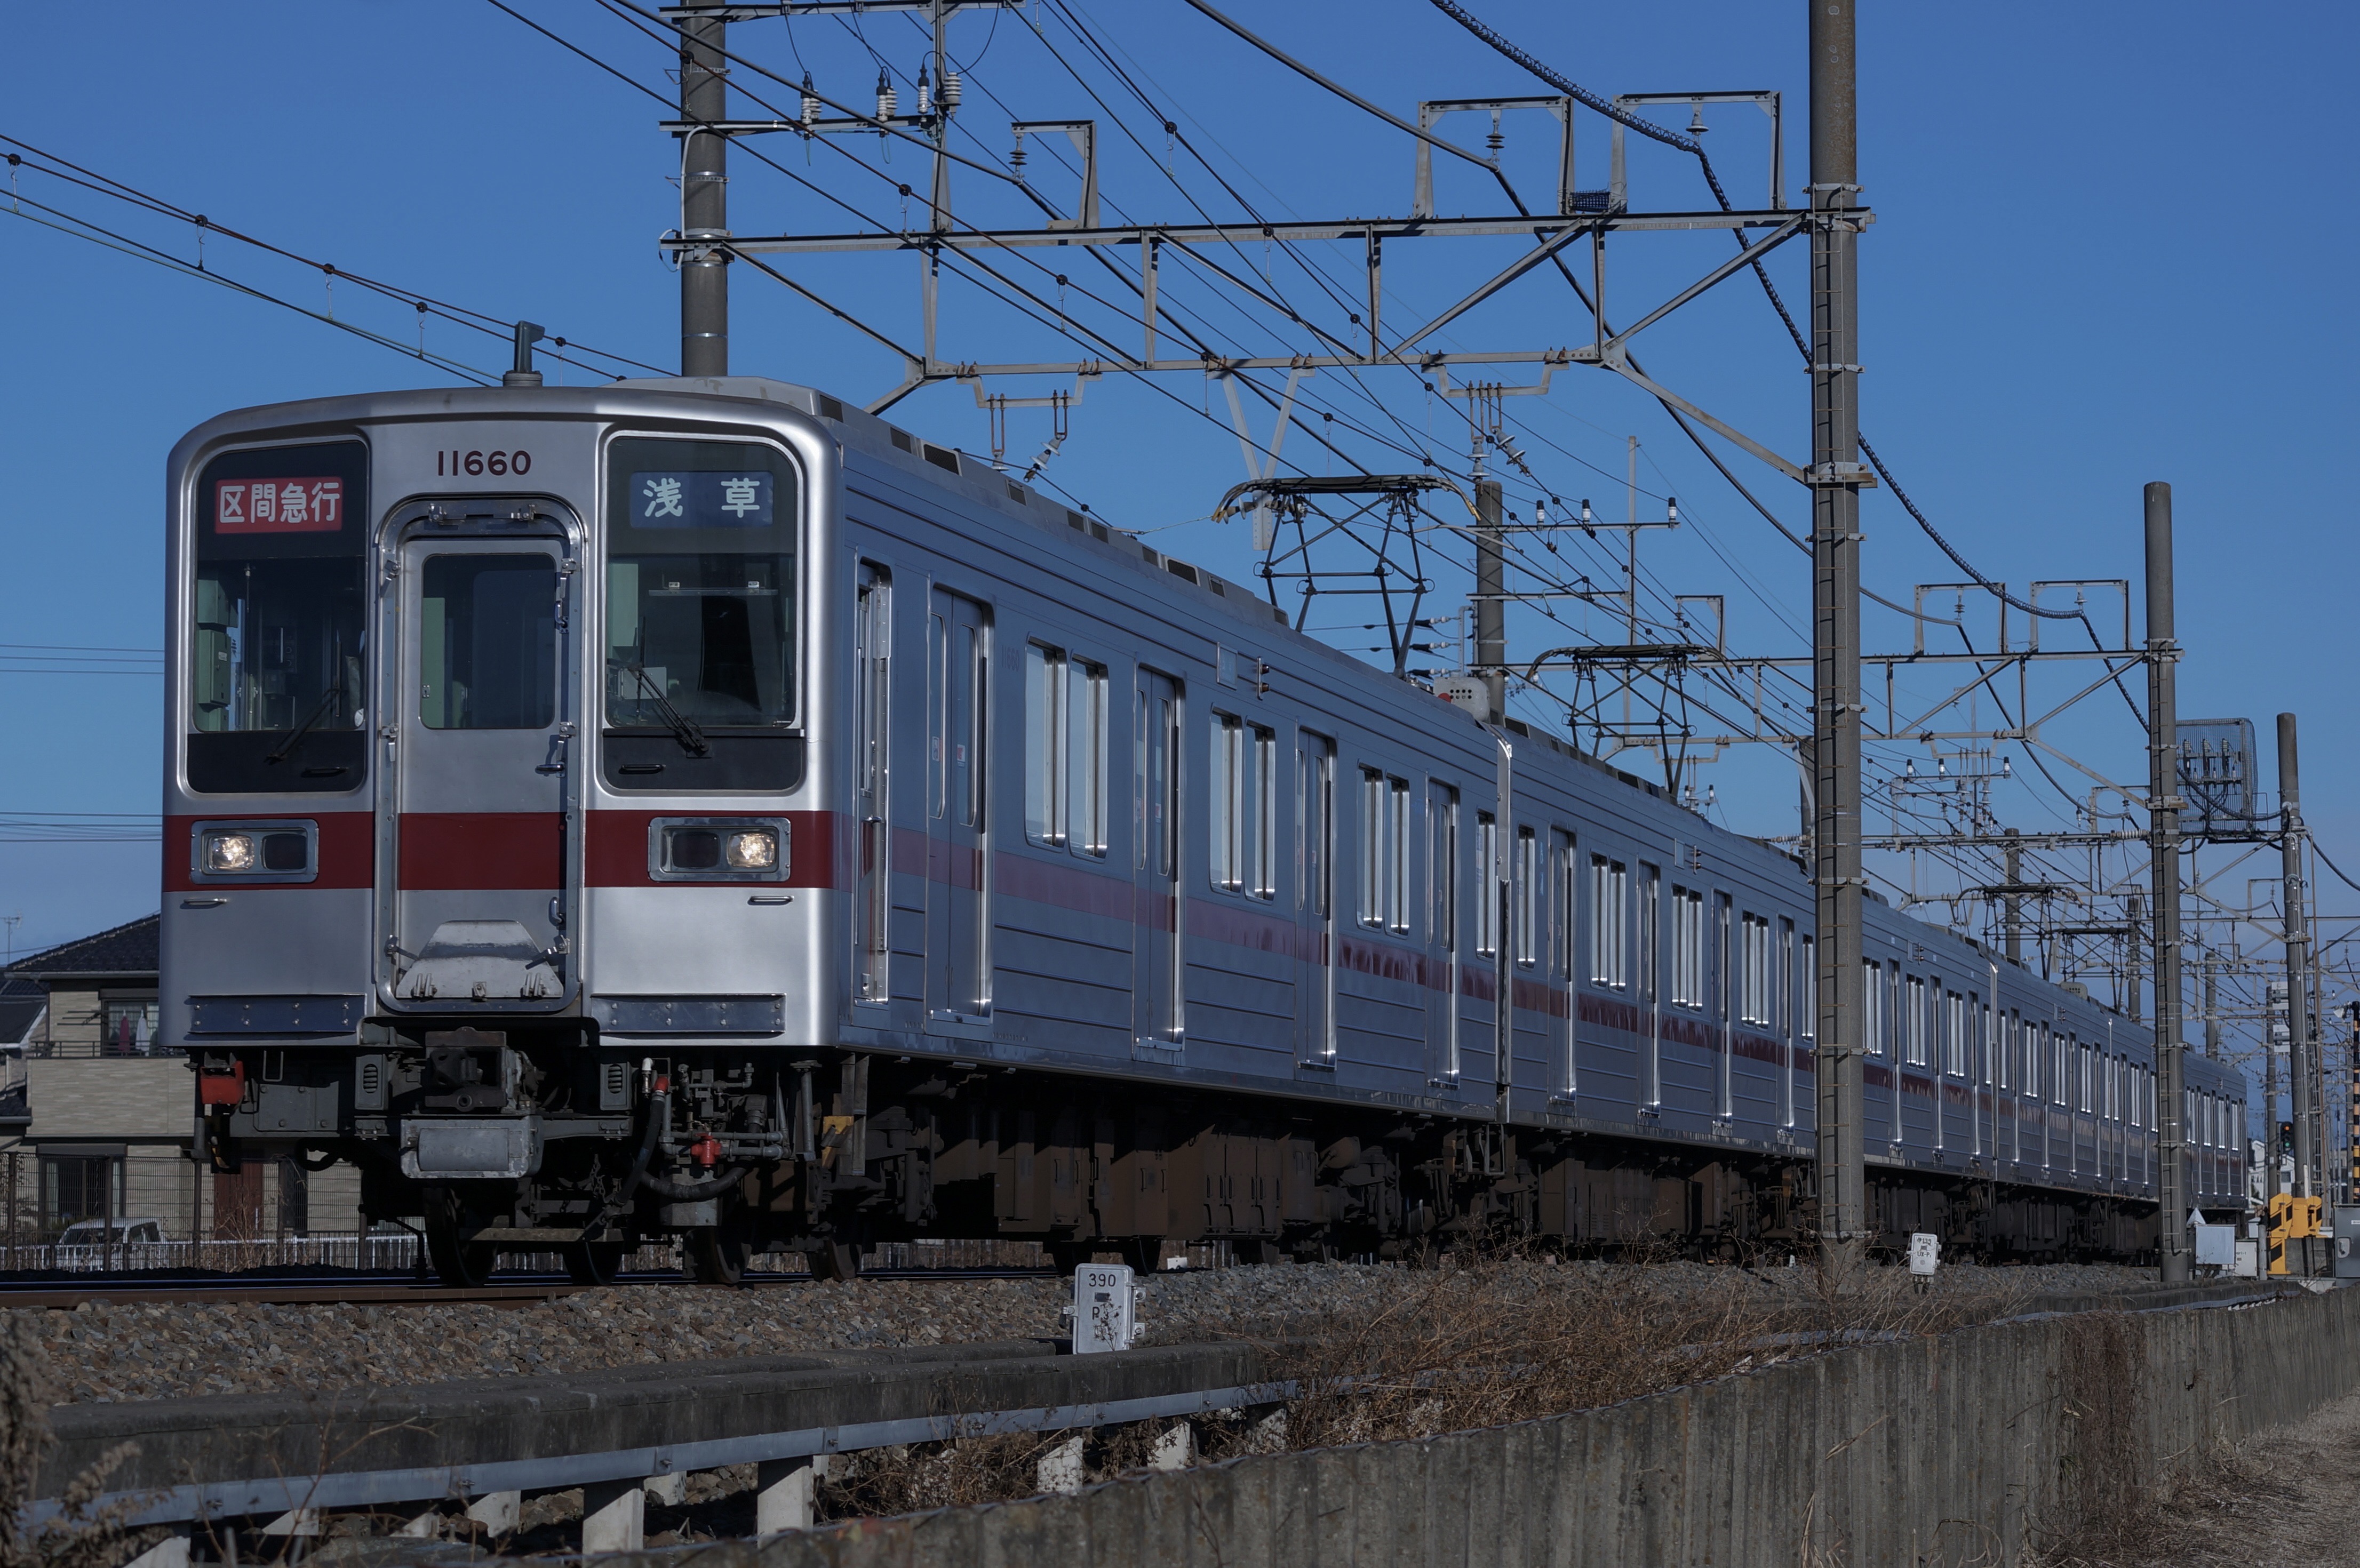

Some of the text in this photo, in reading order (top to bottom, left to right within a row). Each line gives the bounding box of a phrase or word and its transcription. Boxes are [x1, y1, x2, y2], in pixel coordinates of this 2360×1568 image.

[438, 450, 531, 476] 11660
[219, 482, 340, 523] 区間急行
[643, 477, 760, 518] 浅草
[1089, 1273, 1116, 1287] 390
